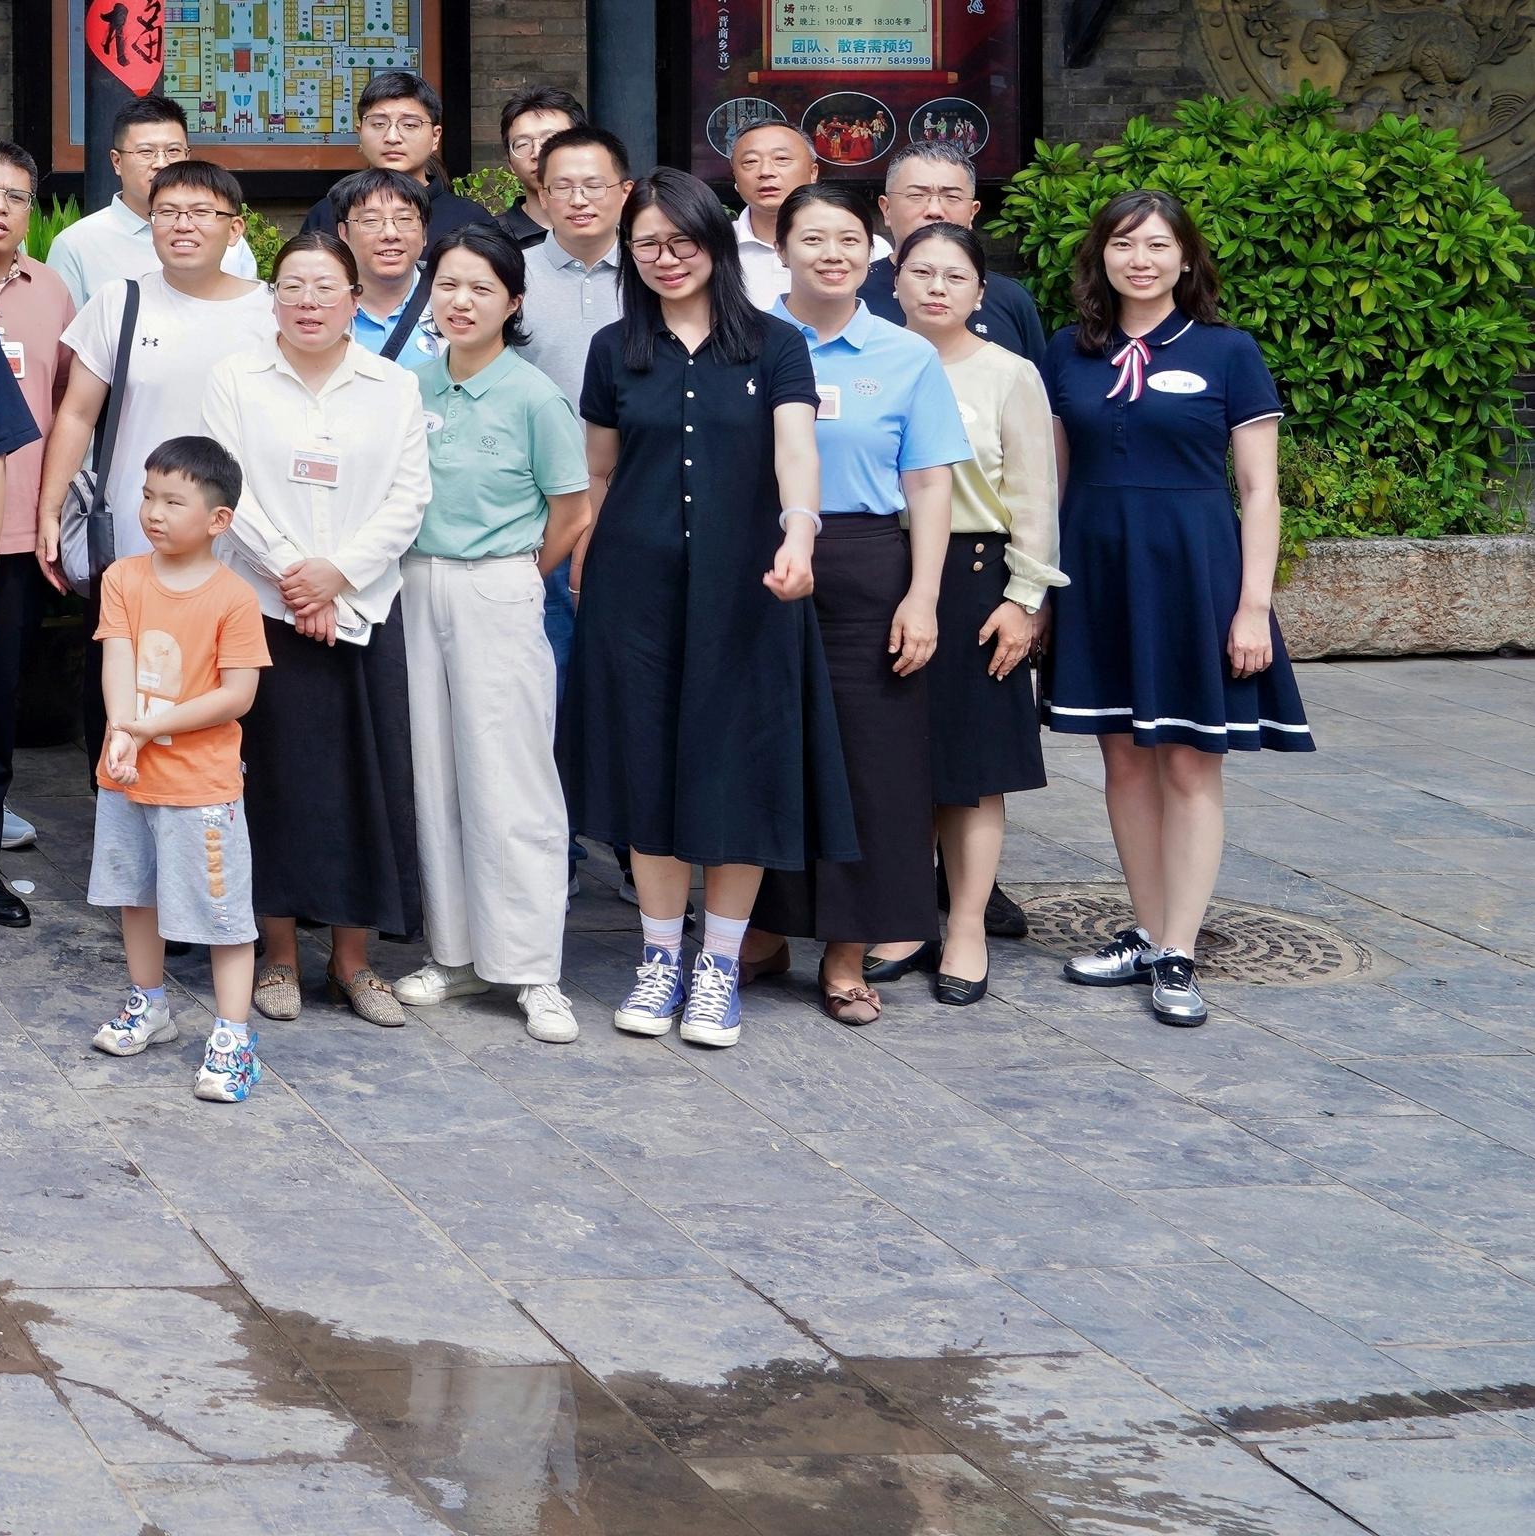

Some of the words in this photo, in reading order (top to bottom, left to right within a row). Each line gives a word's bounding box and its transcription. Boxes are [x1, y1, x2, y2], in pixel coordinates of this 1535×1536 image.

[791, 38, 913, 55] 团队、散客需预约
[887, 56, 932, 66] 5849999
